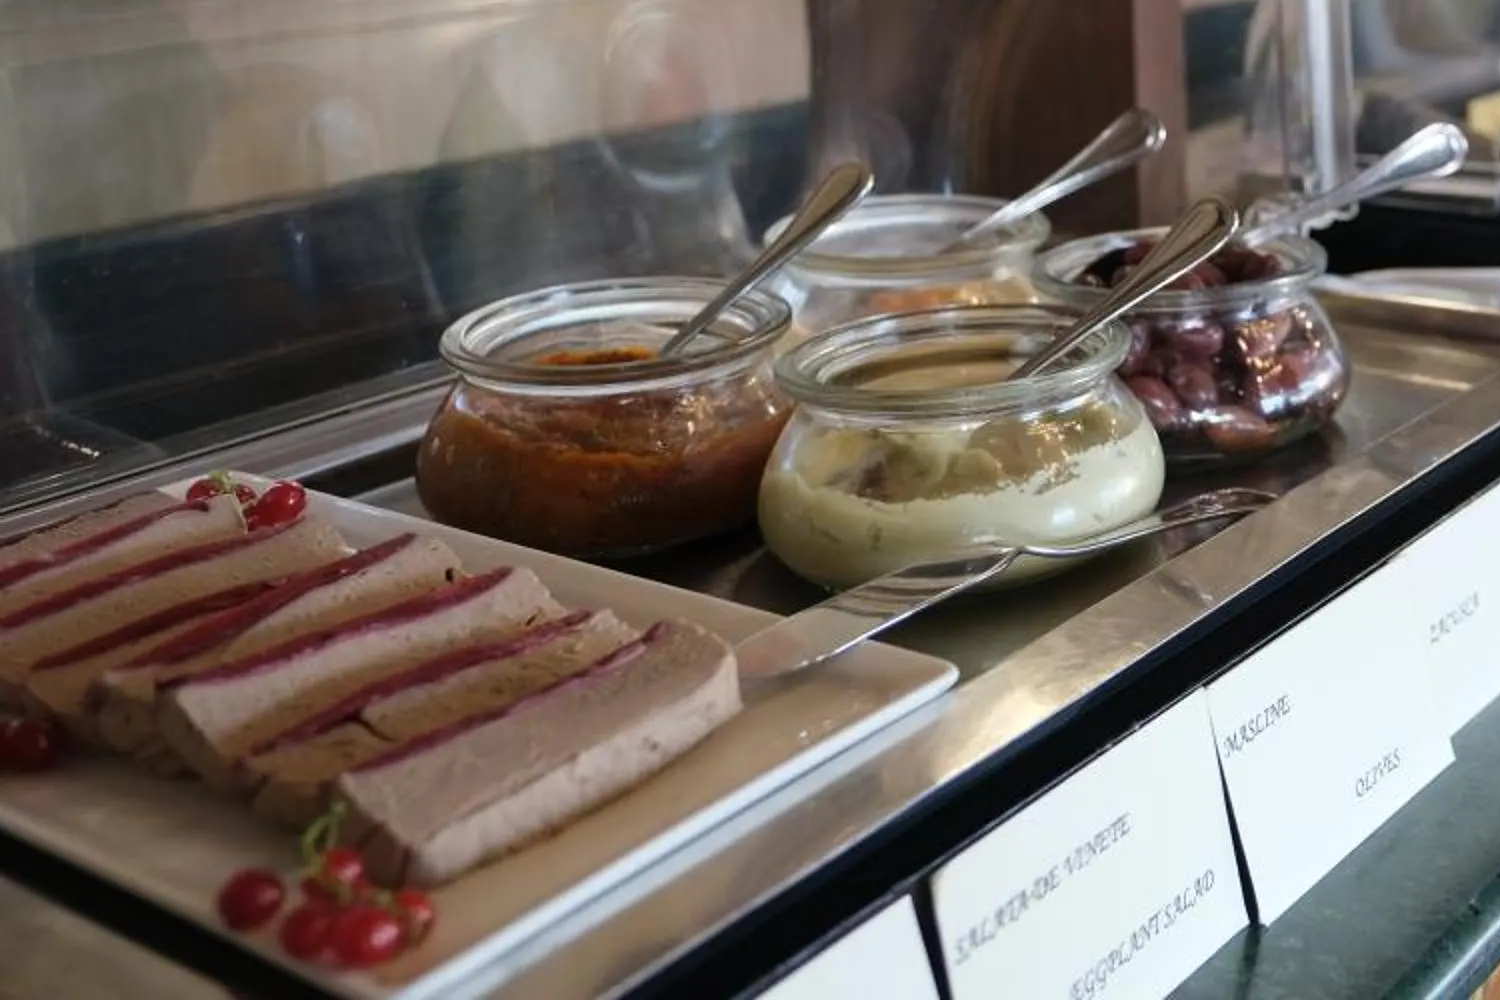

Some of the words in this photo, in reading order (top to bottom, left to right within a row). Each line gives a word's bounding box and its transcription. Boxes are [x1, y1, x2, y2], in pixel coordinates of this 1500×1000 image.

[1354, 747, 1402, 798] OLIVES
[1069, 907, 1162, 1000] EGGPLANT
[1163, 868, 1216, 929] SALAD
